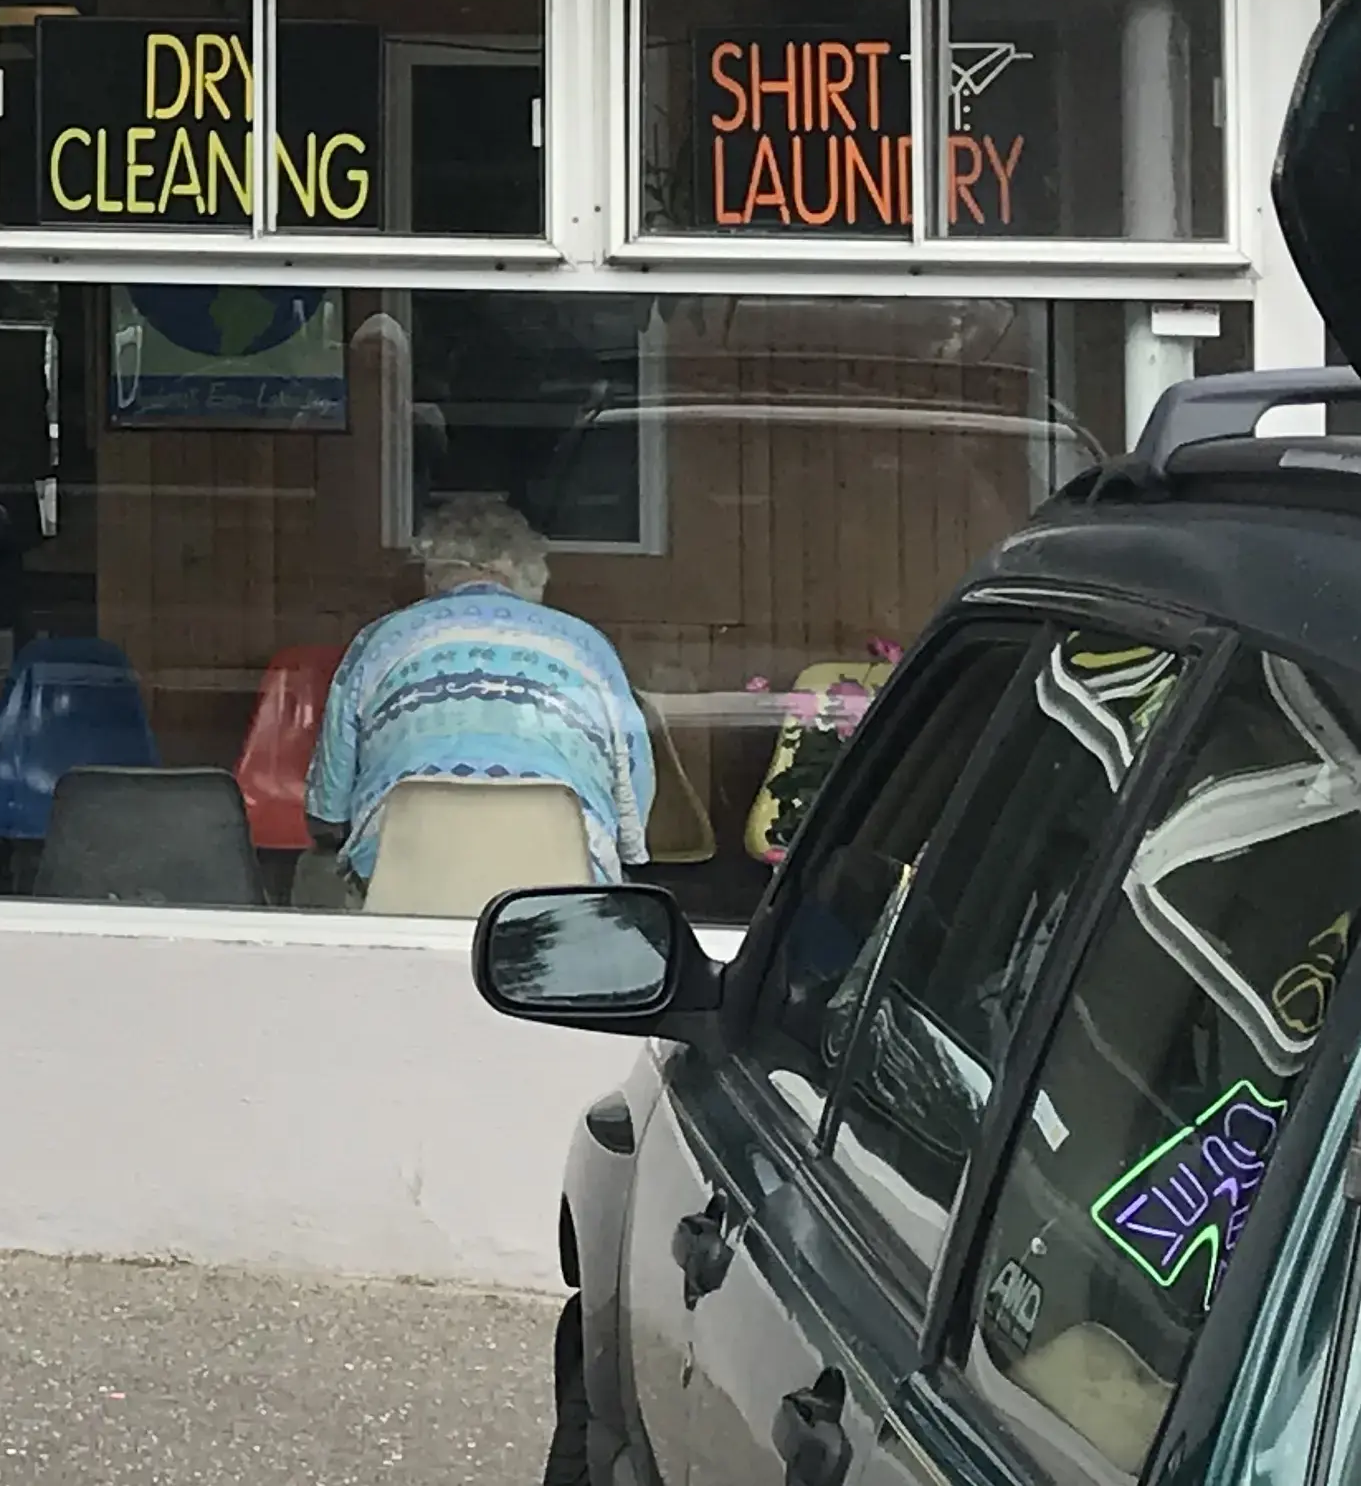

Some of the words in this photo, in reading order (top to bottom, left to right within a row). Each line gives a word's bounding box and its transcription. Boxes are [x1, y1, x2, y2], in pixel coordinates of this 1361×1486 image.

[146, 32, 255, 121] DRY
[710, 41, 891, 131] SHIRT
[50, 126, 370, 220] CLEANNG
